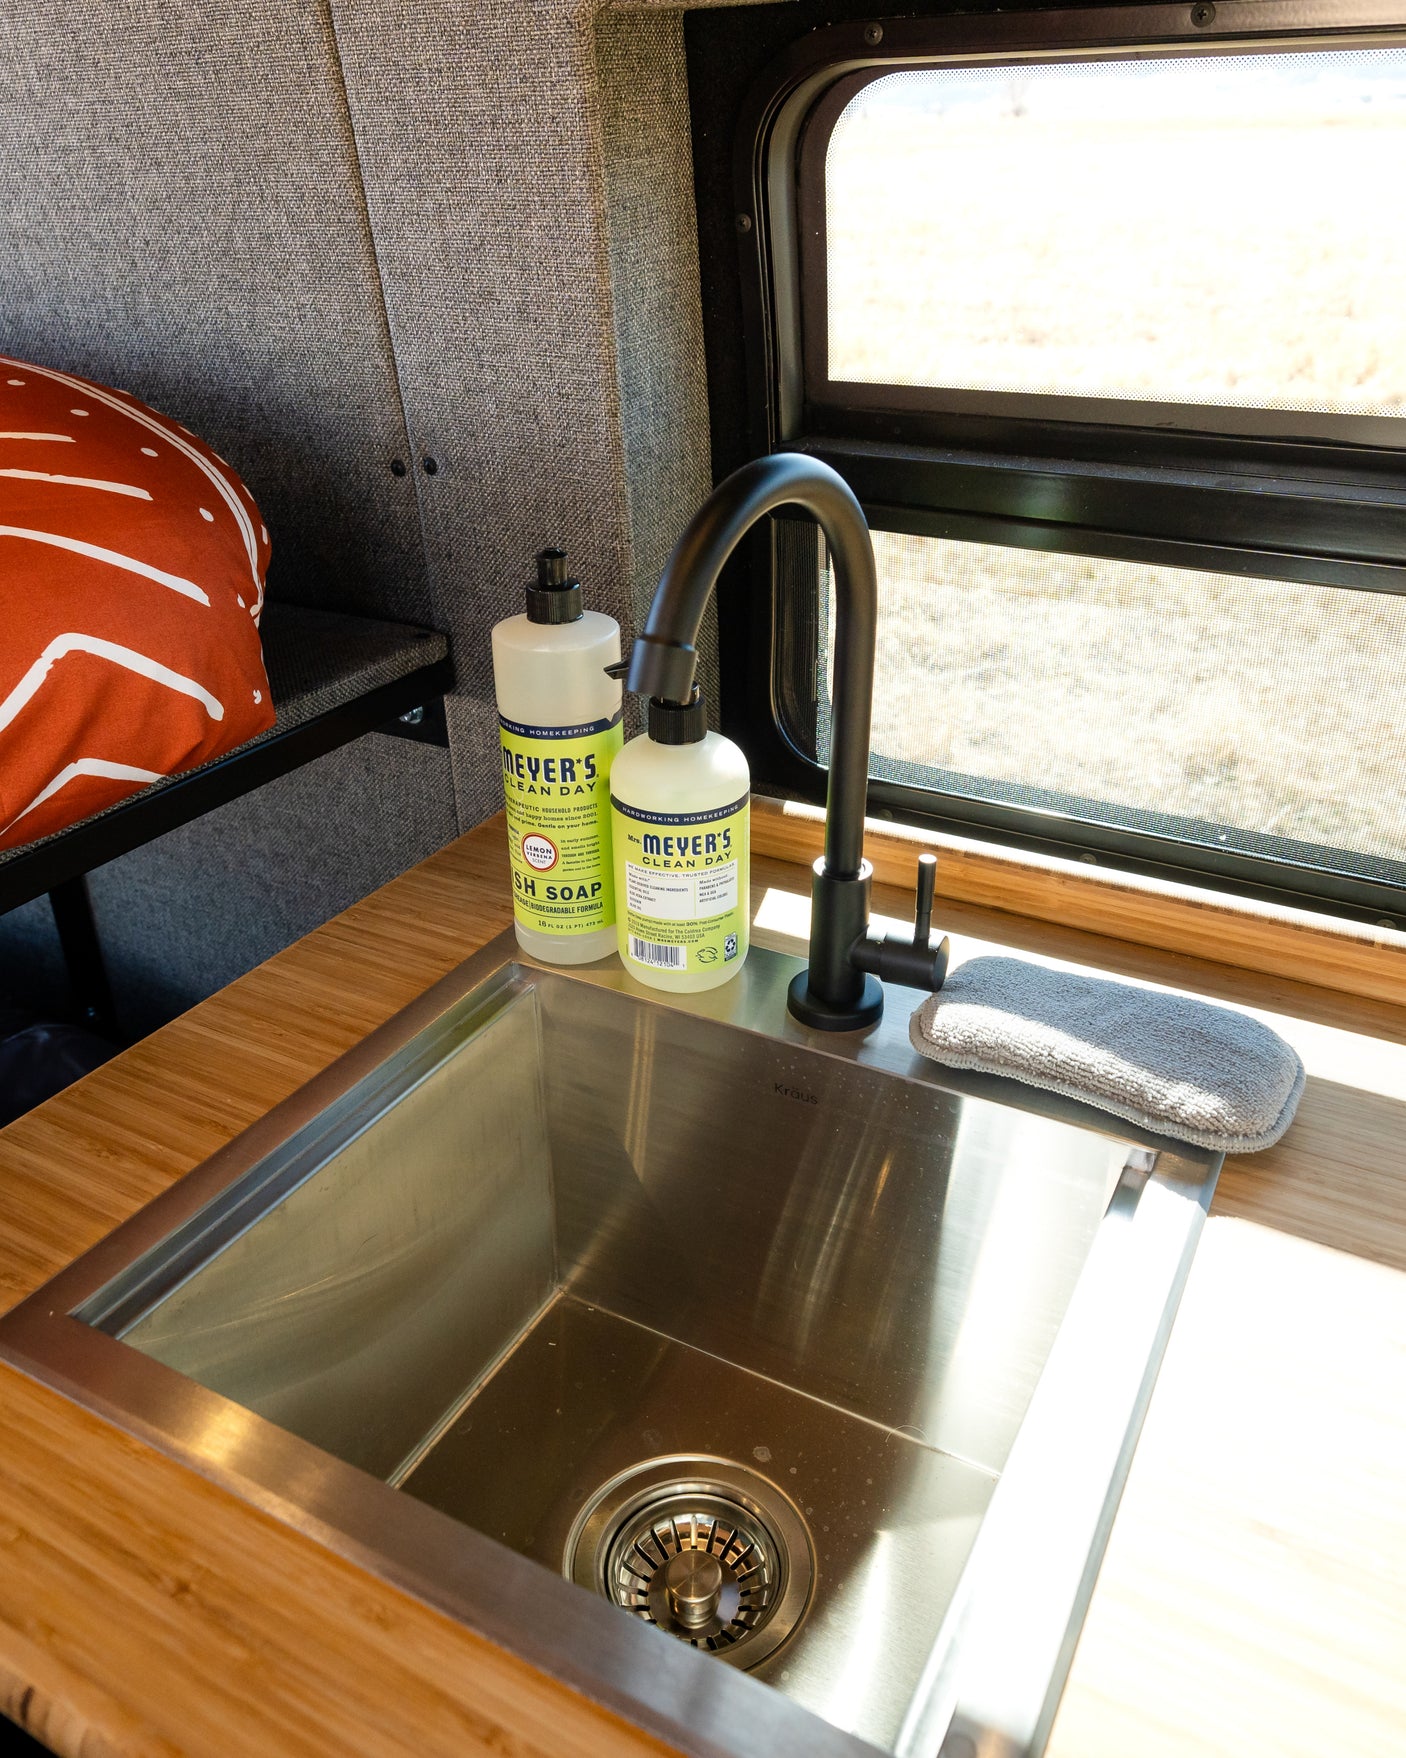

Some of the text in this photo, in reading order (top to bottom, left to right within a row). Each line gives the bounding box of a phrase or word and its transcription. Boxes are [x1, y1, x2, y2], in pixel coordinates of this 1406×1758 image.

[500, 719, 595, 737] ORKING HOMEKEEPING
[504, 773, 596, 796] CLEAN DAY
[574, 802, 598, 813] PRODUCTS
[565, 814, 581, 822] since
[622, 804, 739, 823] HARDWORKING HOMEKEEPING
[537, 822, 556, 830] Gentle
[567, 823, 580, 831] your
[627, 834, 642, 845] Mrs.
[526, 844, 552, 855] LEMON
[526, 851, 553, 860] VERBENA
[642, 851, 731, 869] CLEAN DAY
[634, 866, 649, 875] MAKE
[546, 882, 602, 901] SOAP
[530, 902, 575, 914] BIODEGRADABLE
[577, 901, 603, 912] FORMULA
[640, 922, 667, 934] Manufactured
[702, 924, 720, 933] Company
